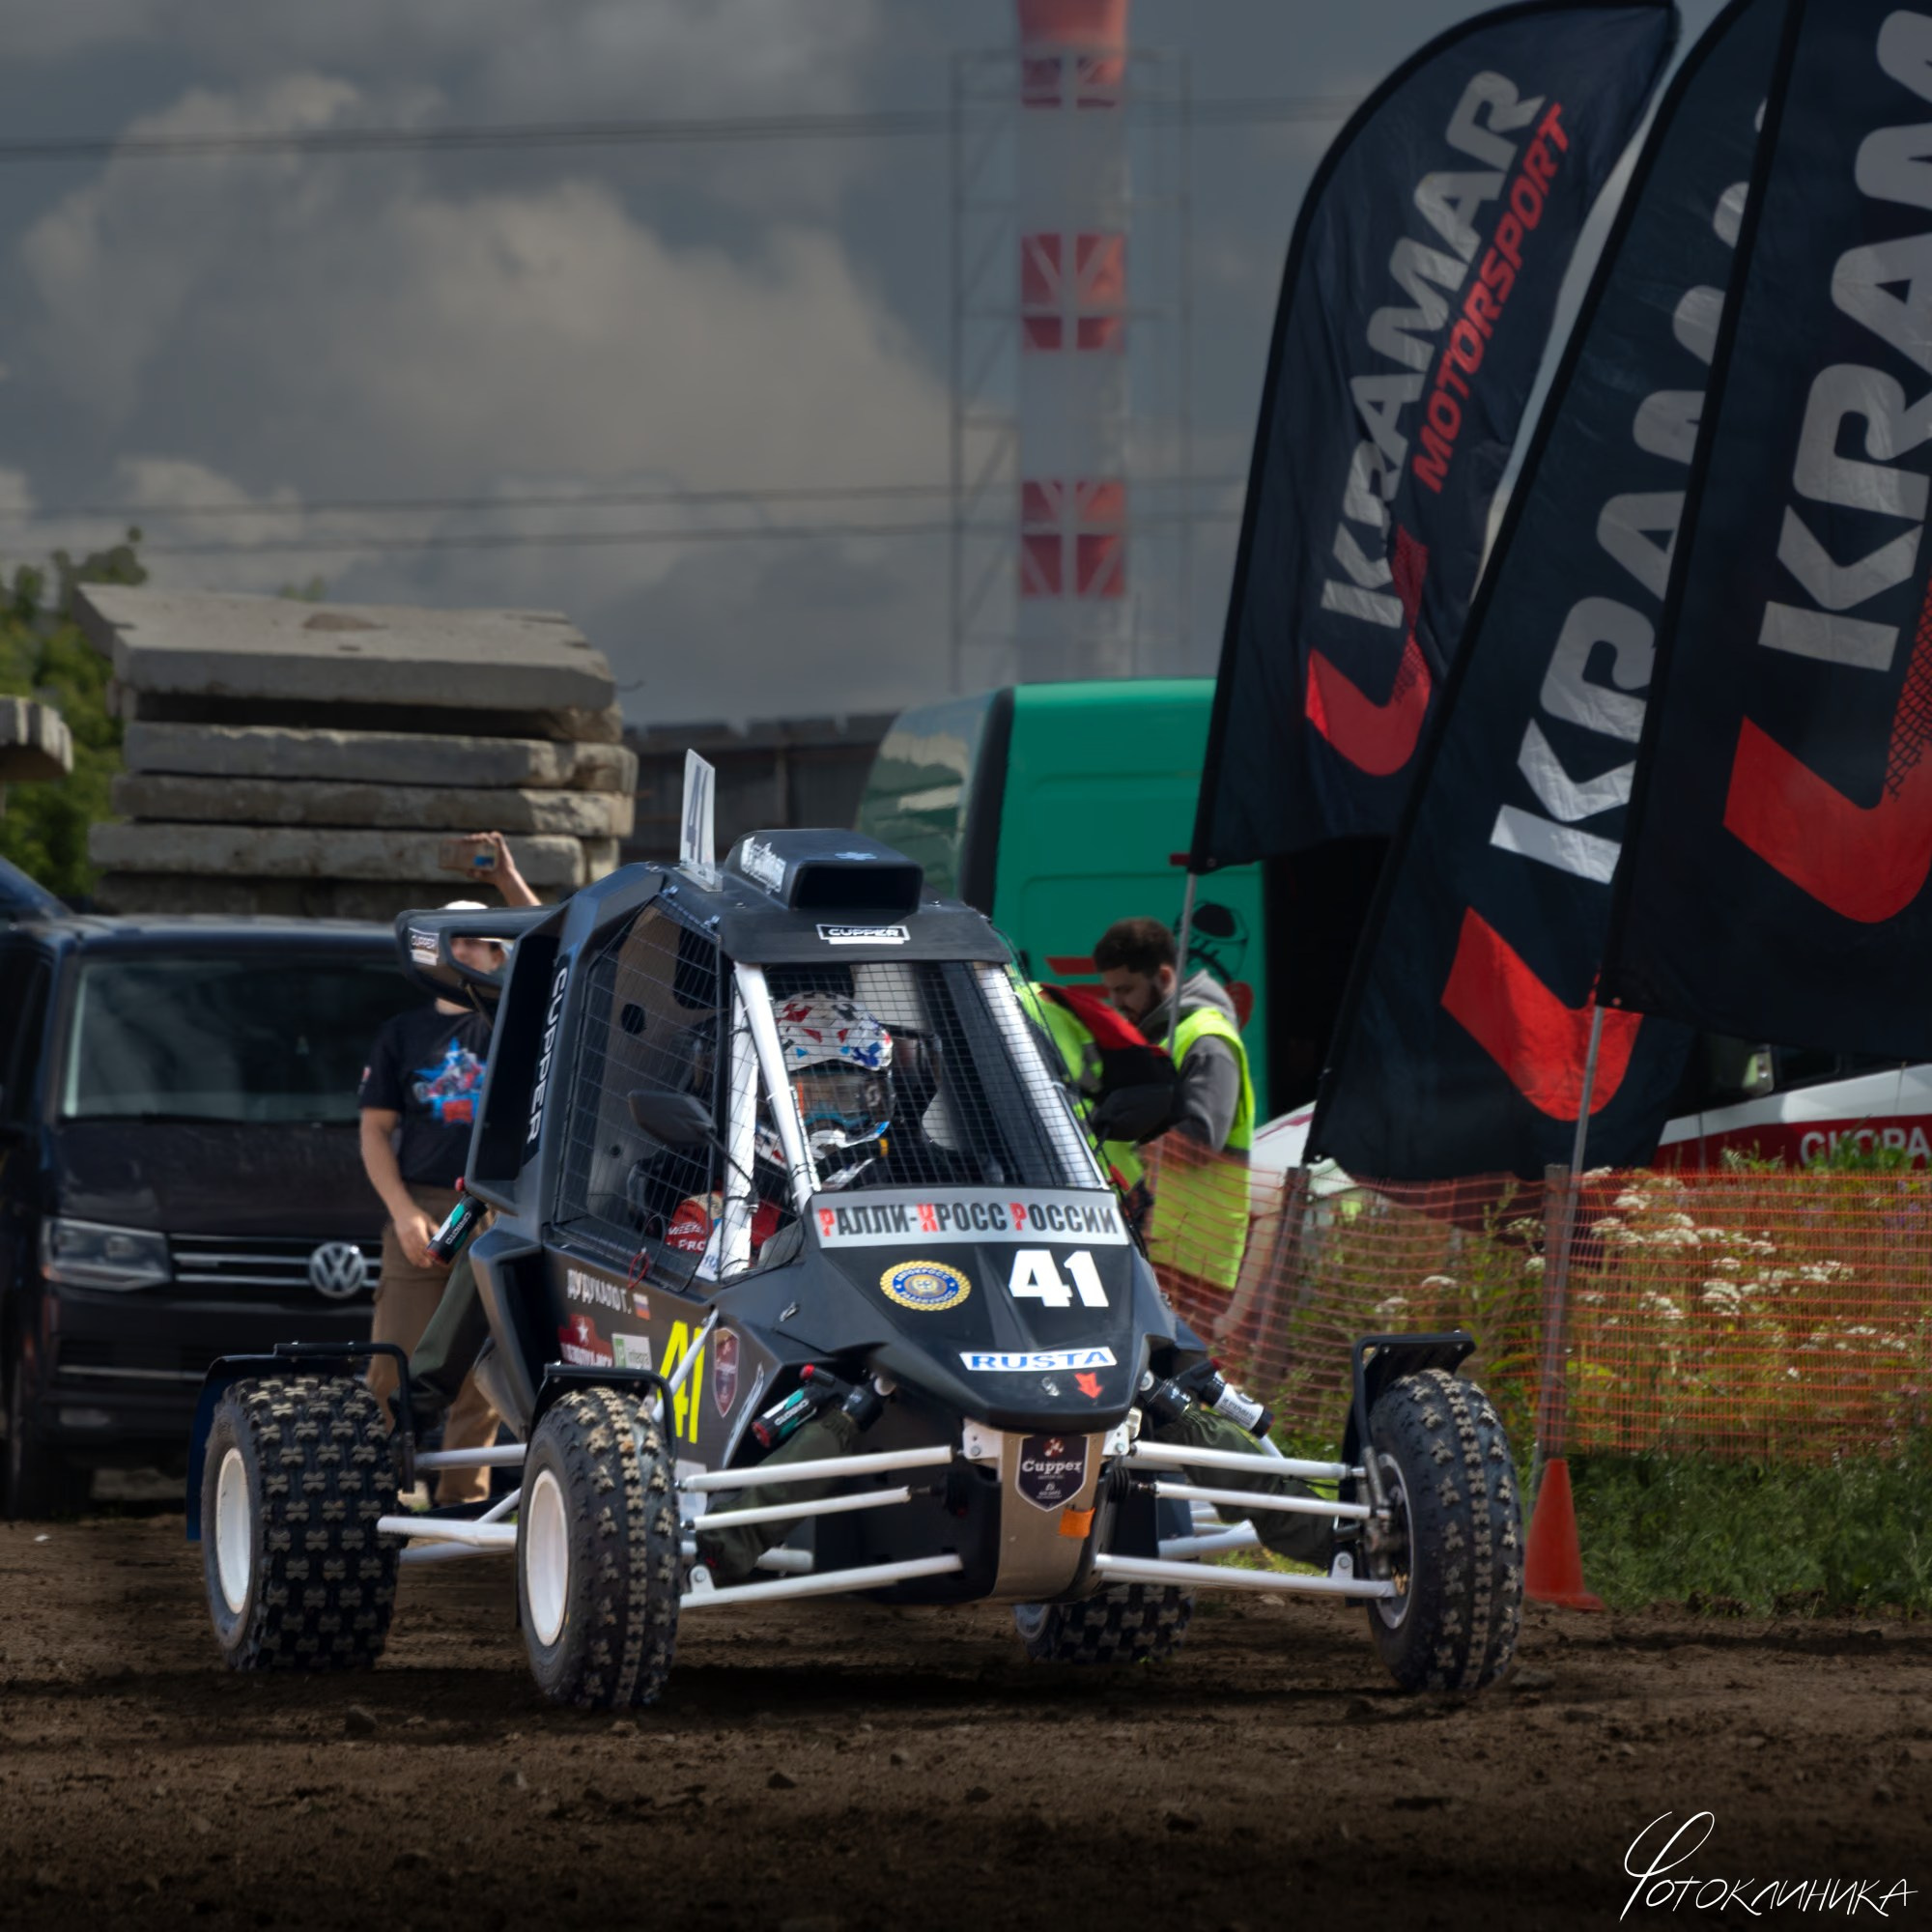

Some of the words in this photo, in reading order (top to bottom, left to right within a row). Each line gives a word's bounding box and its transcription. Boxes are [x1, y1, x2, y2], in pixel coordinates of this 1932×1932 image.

[1411, 102, 1572, 494] MOTORSPORT
[1320, 70, 1546, 630] KRAMAR
[827, 927, 900, 938] CUPPER
[526, 967, 568, 1145] CUPPER
[1009, 1203, 1119, 1235] РОССИИ
[1009, 1250, 1110, 1308] 41
[657, 1320, 705, 1444] 41
[971, 1350, 1111, 1370] RUSTA
[1021, 1457, 1083, 1475] Cupper
